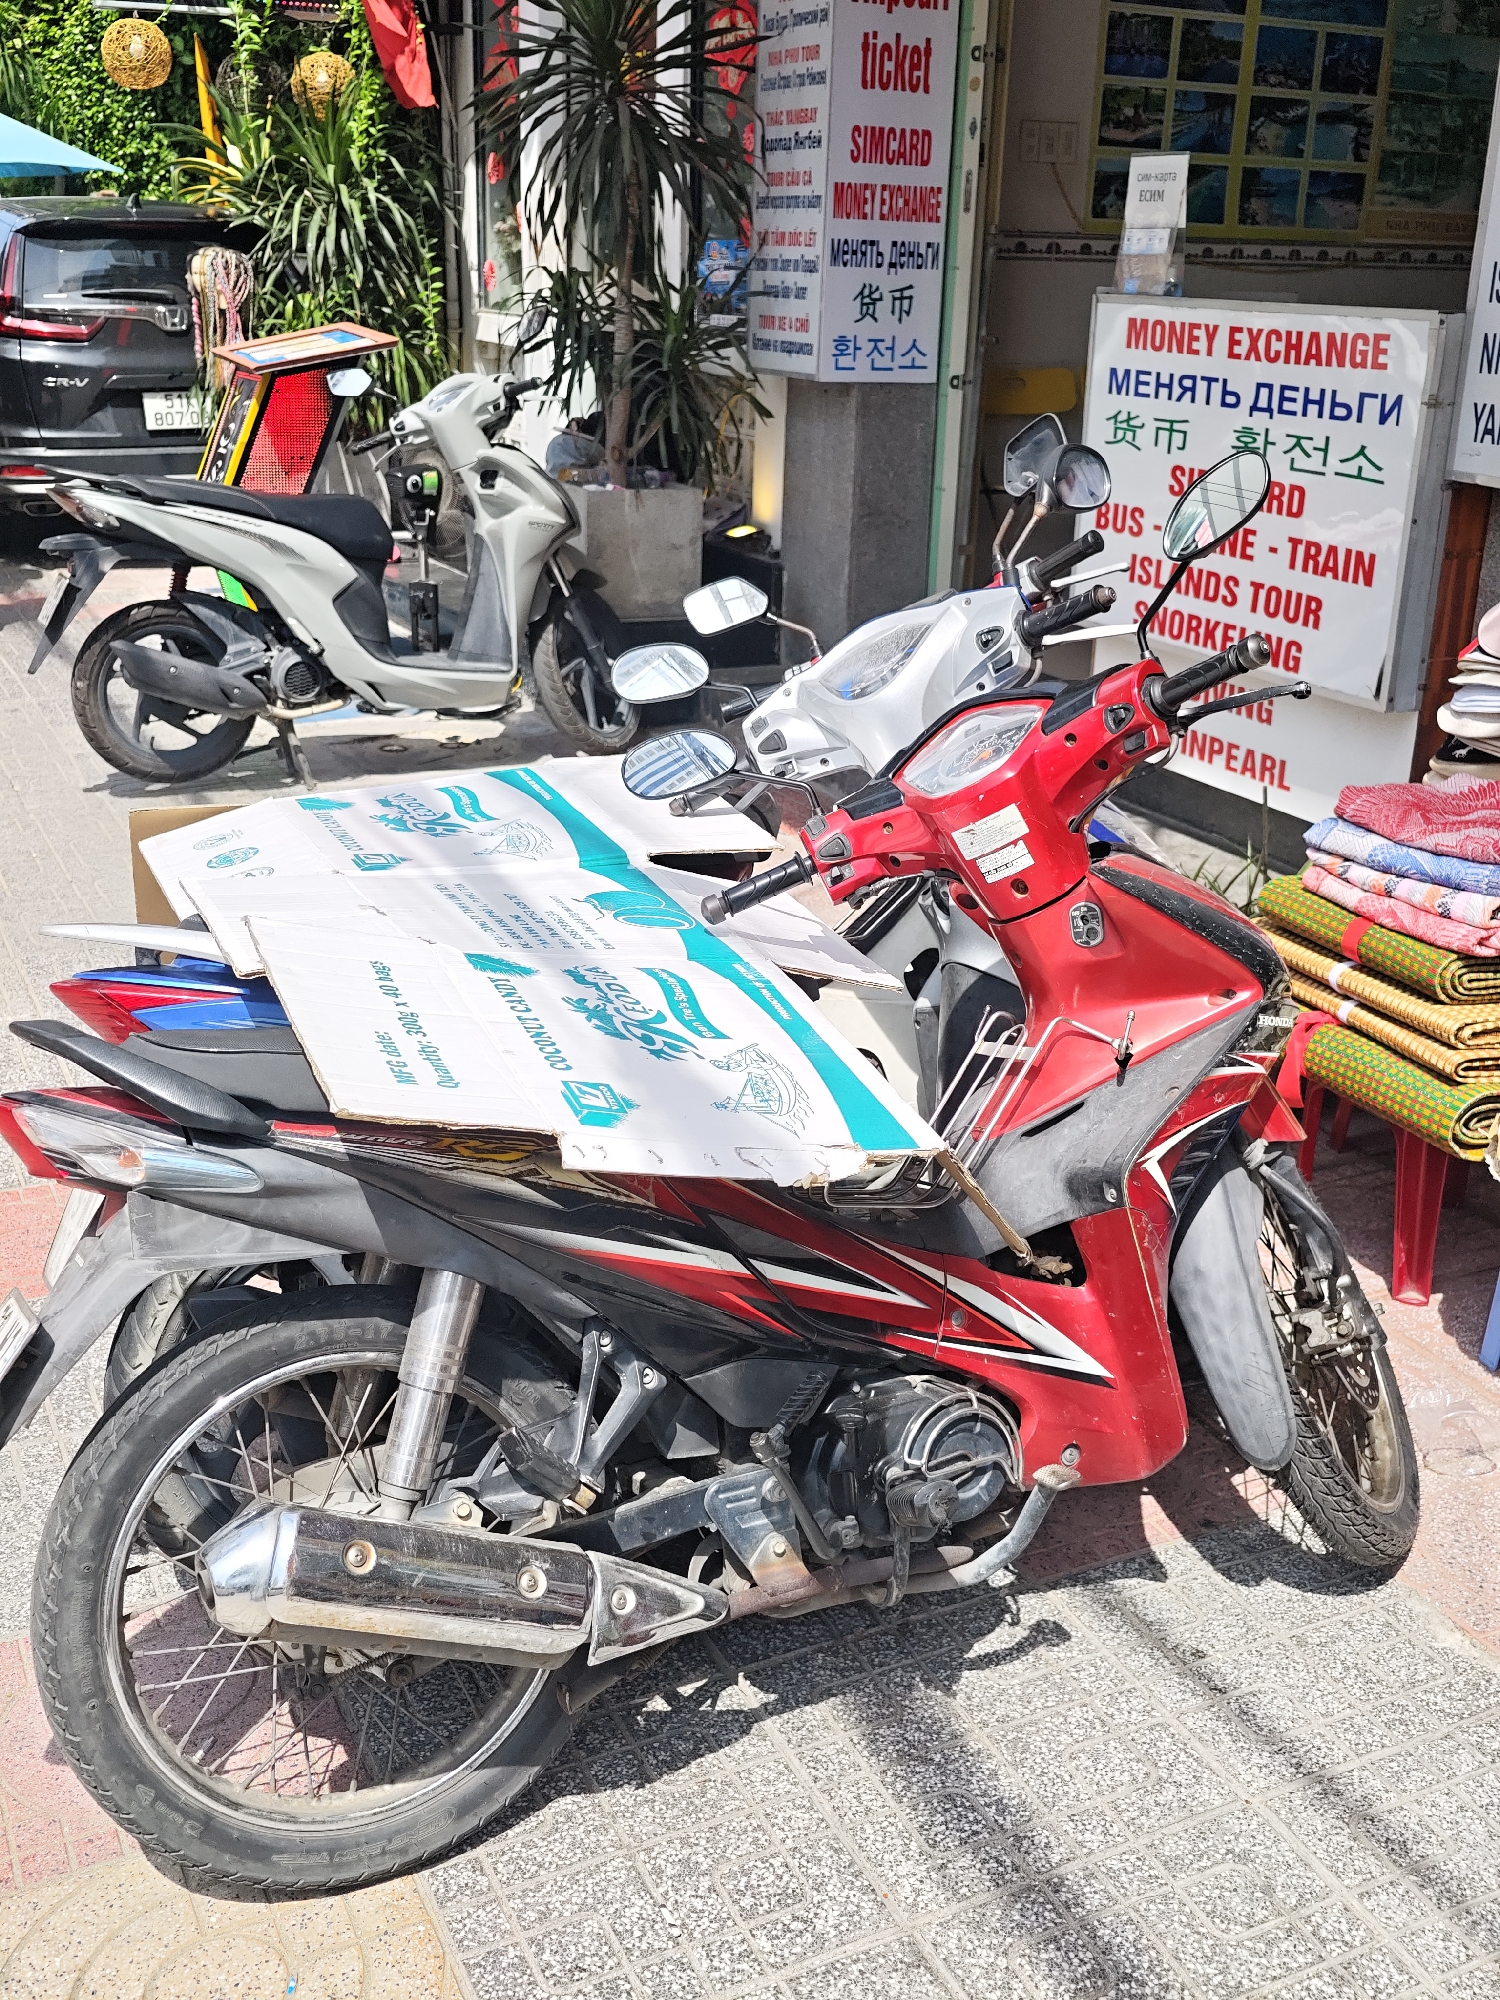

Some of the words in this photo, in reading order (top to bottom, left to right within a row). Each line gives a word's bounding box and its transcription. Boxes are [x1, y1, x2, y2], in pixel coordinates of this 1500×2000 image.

[802, 44, 820, 62] TOUR
[861, 31, 932, 94] ticket
[850, 124, 932, 166] SIMCARD
[767, 172, 784, 188] TOUR
[1137, 172, 1177, 186] сим-карта
[833, 182, 877, 220] MONEY
[879, 184, 943, 223] EXCHANGE
[887, 240, 940, 276] деньги
[852, 282, 915, 325] 货币
[759, 314, 776, 331] TOUR
[831, 334, 929, 371] 환전소
[1126, 317, 1219, 357] MONEY
[1227, 326, 1391, 371] EXCHANGE
[42, 376, 89, 388] CR-V
[1108, 367, 1241, 410] МЕНЯТЬ
[1249, 382, 1404, 427] ДЕНЬГИ
[1105, 410, 1189, 455] 货币
[1473, 402, 1500, 446] YA
[1095, 502, 1144, 538] BUS
[1287, 536, 1377, 588] TRAIN
[1128, 554, 1240, 608] ISLANDS
[1249, 580, 1323, 631] TOUR
[1180, 729, 1291, 792] INPEARL
[369, 960, 393, 983] bags
[379, 985, 404, 998] 40
[488, 976, 532, 1013] CANDY
[760, 986, 794, 1021] PRODUCTION
[398, 1011, 428, 1038] 300g
[678, 1002, 698, 1021] Tre's
[1257, 1014, 1293, 1028] HONDA
[374, 1031, 401, 1057] date:
[516, 1015, 573, 1071] COCONUT
[691, 1021, 718, 1039] Ben
[386, 1060, 419, 1086] MFG
[417, 1040, 459, 1089] Quantity:
